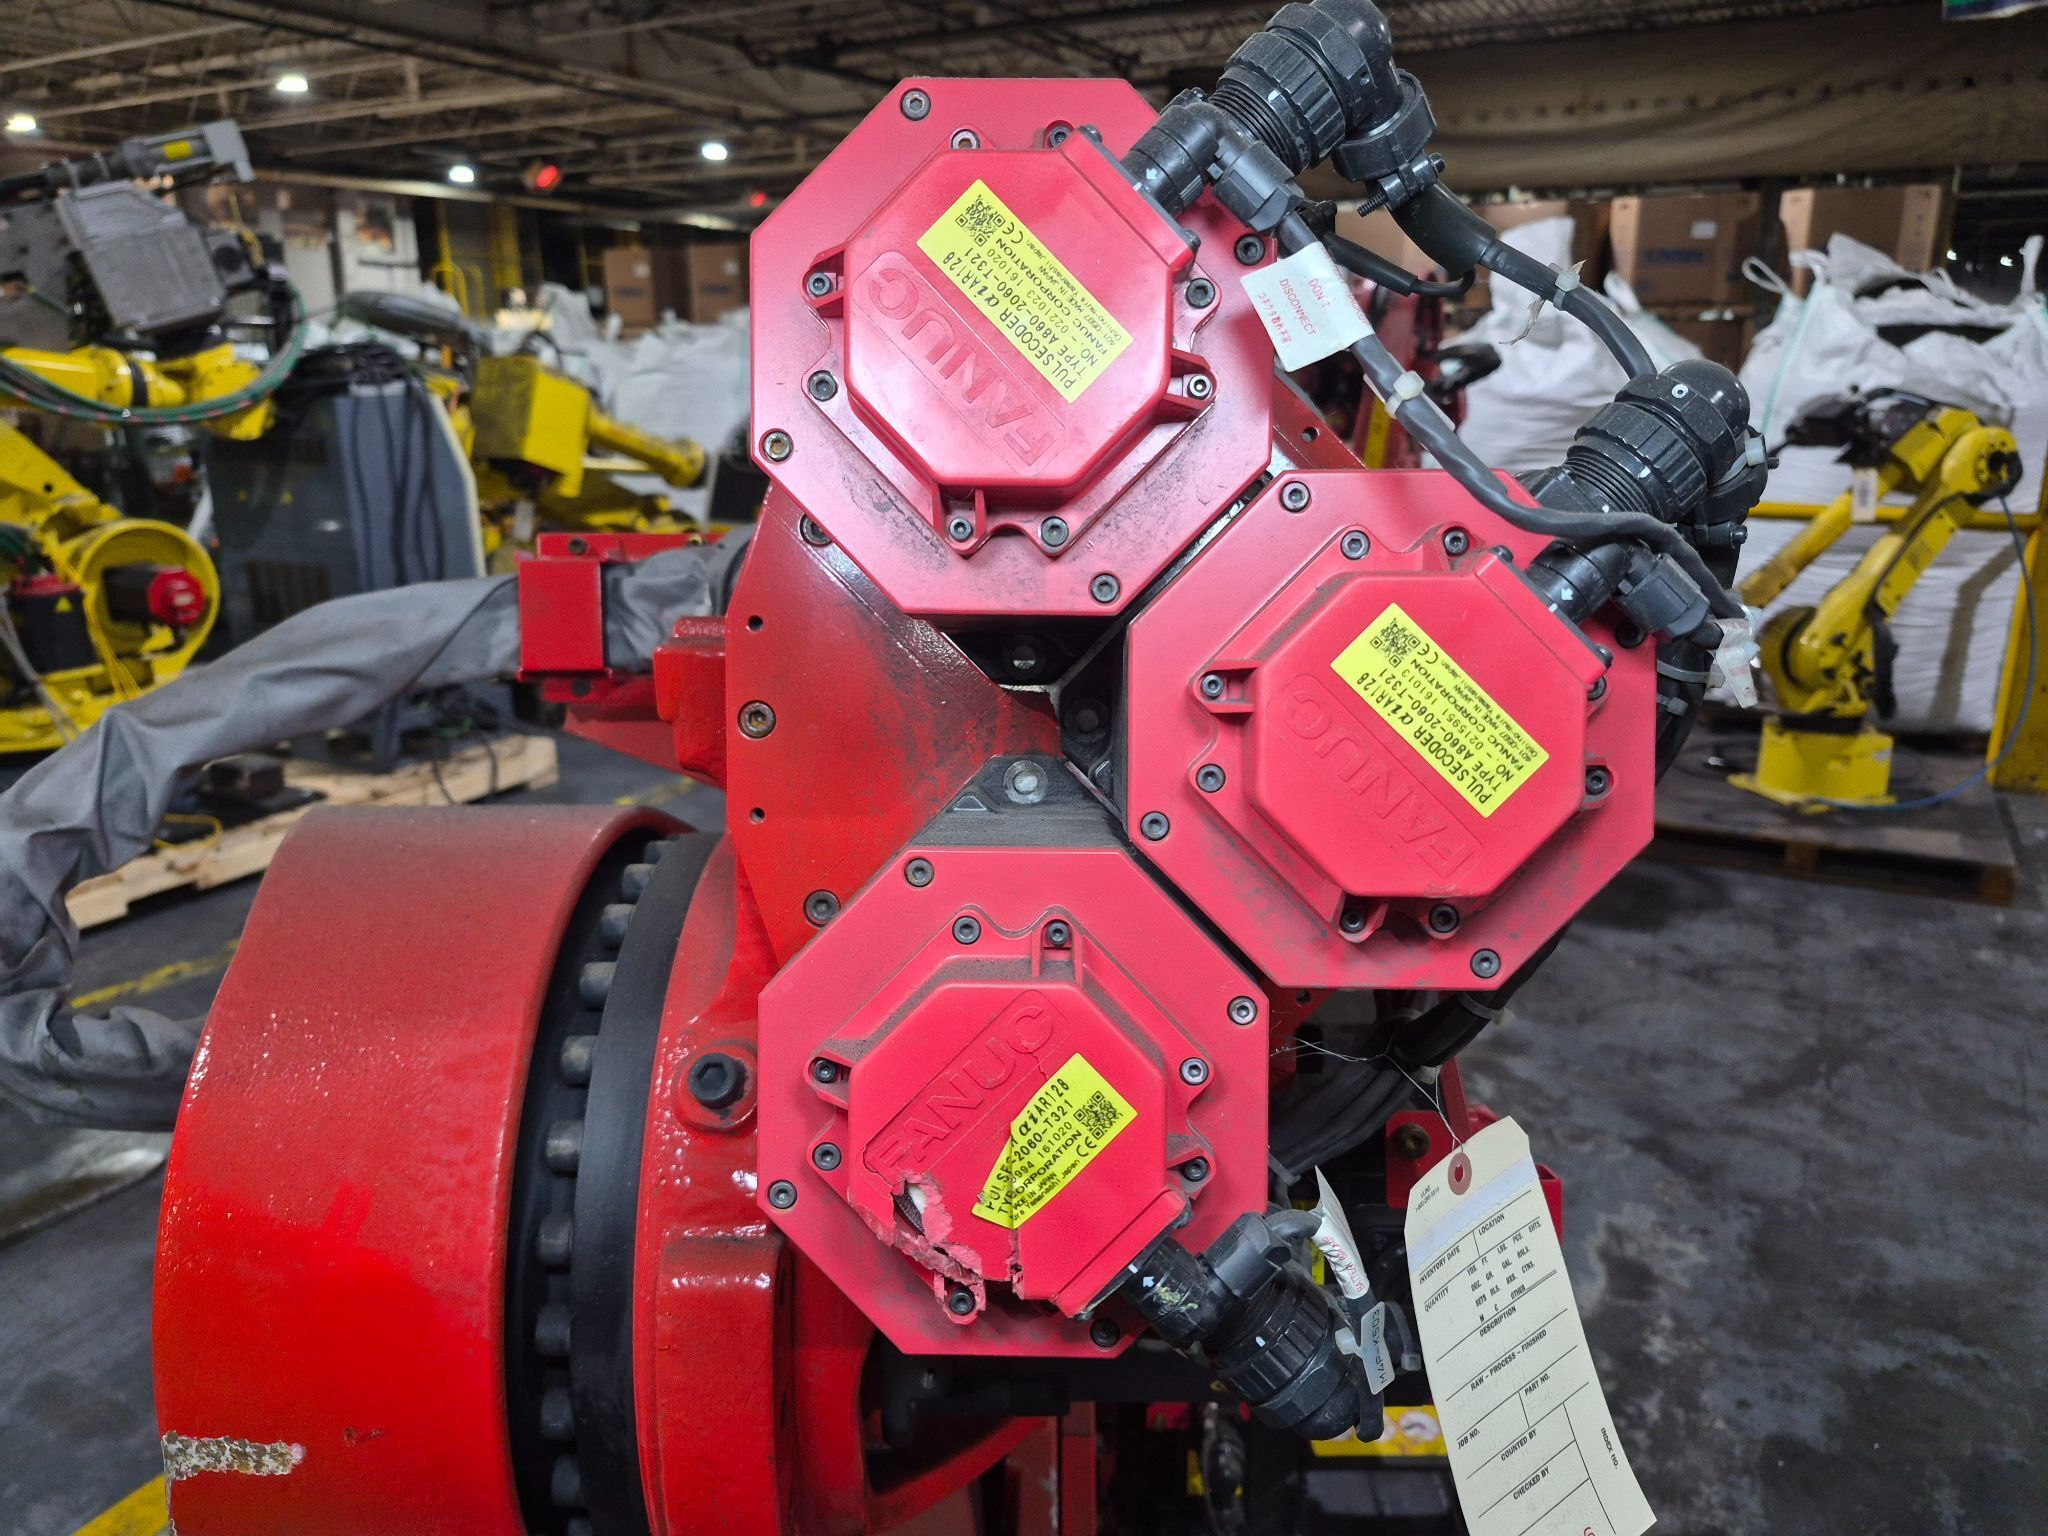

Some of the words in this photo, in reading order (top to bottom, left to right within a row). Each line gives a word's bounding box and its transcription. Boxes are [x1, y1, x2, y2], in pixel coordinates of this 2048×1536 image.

[985, 246, 1024, 287] 161020
[1024, 238, 1046, 261] Japan
[994, 236, 1071, 316] CORPORATION
[1037, 264, 1059, 287] JAPAN
[1043, 259, 1081, 297] Yamanashi
[1057, 285, 1068, 296] IN
[963, 246, 1059, 346] A860-2060-T321
[1025, 288, 1069, 334] 0221023
[1066, 295, 1085, 314] MADE
[1280, 278, 1316, 335] DISCONNECT
[997, 306, 1076, 389] PULSECODER
[1071, 316, 1108, 355] FANUC
[869, 268, 1056, 466] FANUC
[1056, 343, 1087, 376] TYPE
[1399, 667, 1438, 705] 161013
[1439, 658, 1461, 681] Japan
[1409, 657, 1486, 734] CORPORATION
[1451, 683, 1474, 705] JAPAN
[1458, 678, 1494, 714] Yamanashi
[1472, 703, 1482, 713] IN
[1376, 666, 1474, 762] A860-2060-T321
[1440, 707, 1484, 750] 0215951
[1481, 712, 1499, 730] MADE
[1411, 724, 1492, 804] PULSECODER
[1486, 733, 1524, 771] FANUC
[1283, 690, 1475, 879] FANUC
[1471, 759, 1503, 791] TYPE
[866, 1006, 1054, 1170] FANUC
[1037, 1121, 1072, 1158] 161020
[1027, 1189, 1036, 1199] IN
[1037, 1171, 1057, 1191] JAPAN
[1062, 1159, 1080, 1179] Japan
[1478, 1213, 1505, 1235] LOCATION
[1419, 1257, 1447, 1284] INVENTORY
[1447, 1245, 1461, 1261] DATE
[1424, 1286, 1449, 1312] QUANTITY
[1475, 1294, 1487, 1307] SETS
[1511, 1284, 1526, 1300] OTHER
[1479, 1305, 1517, 1338] DESCRIPTION
[1470, 1378, 1484, 1391] RAW
[1489, 1352, 1517, 1377] PROCESS
[1521, 1329, 1547, 1353] FINISHED
[1524, 1381, 1539, 1396] PART
[1540, 1373, 1551, 1384] NO.
[1457, 1436, 1469, 1450] JOB
[1469, 1428, 1480, 1440] NO.
[1500, 1436, 1528, 1462] COUNTED
[1529, 1428, 1537, 1441] BY
[1600, 1427, 1614, 1454] INDEX
[1610, 1453, 1620, 1470] NO.
[1513, 1474, 1541, 1500] CHECKED
[1541, 1466, 1550, 1479] BY
